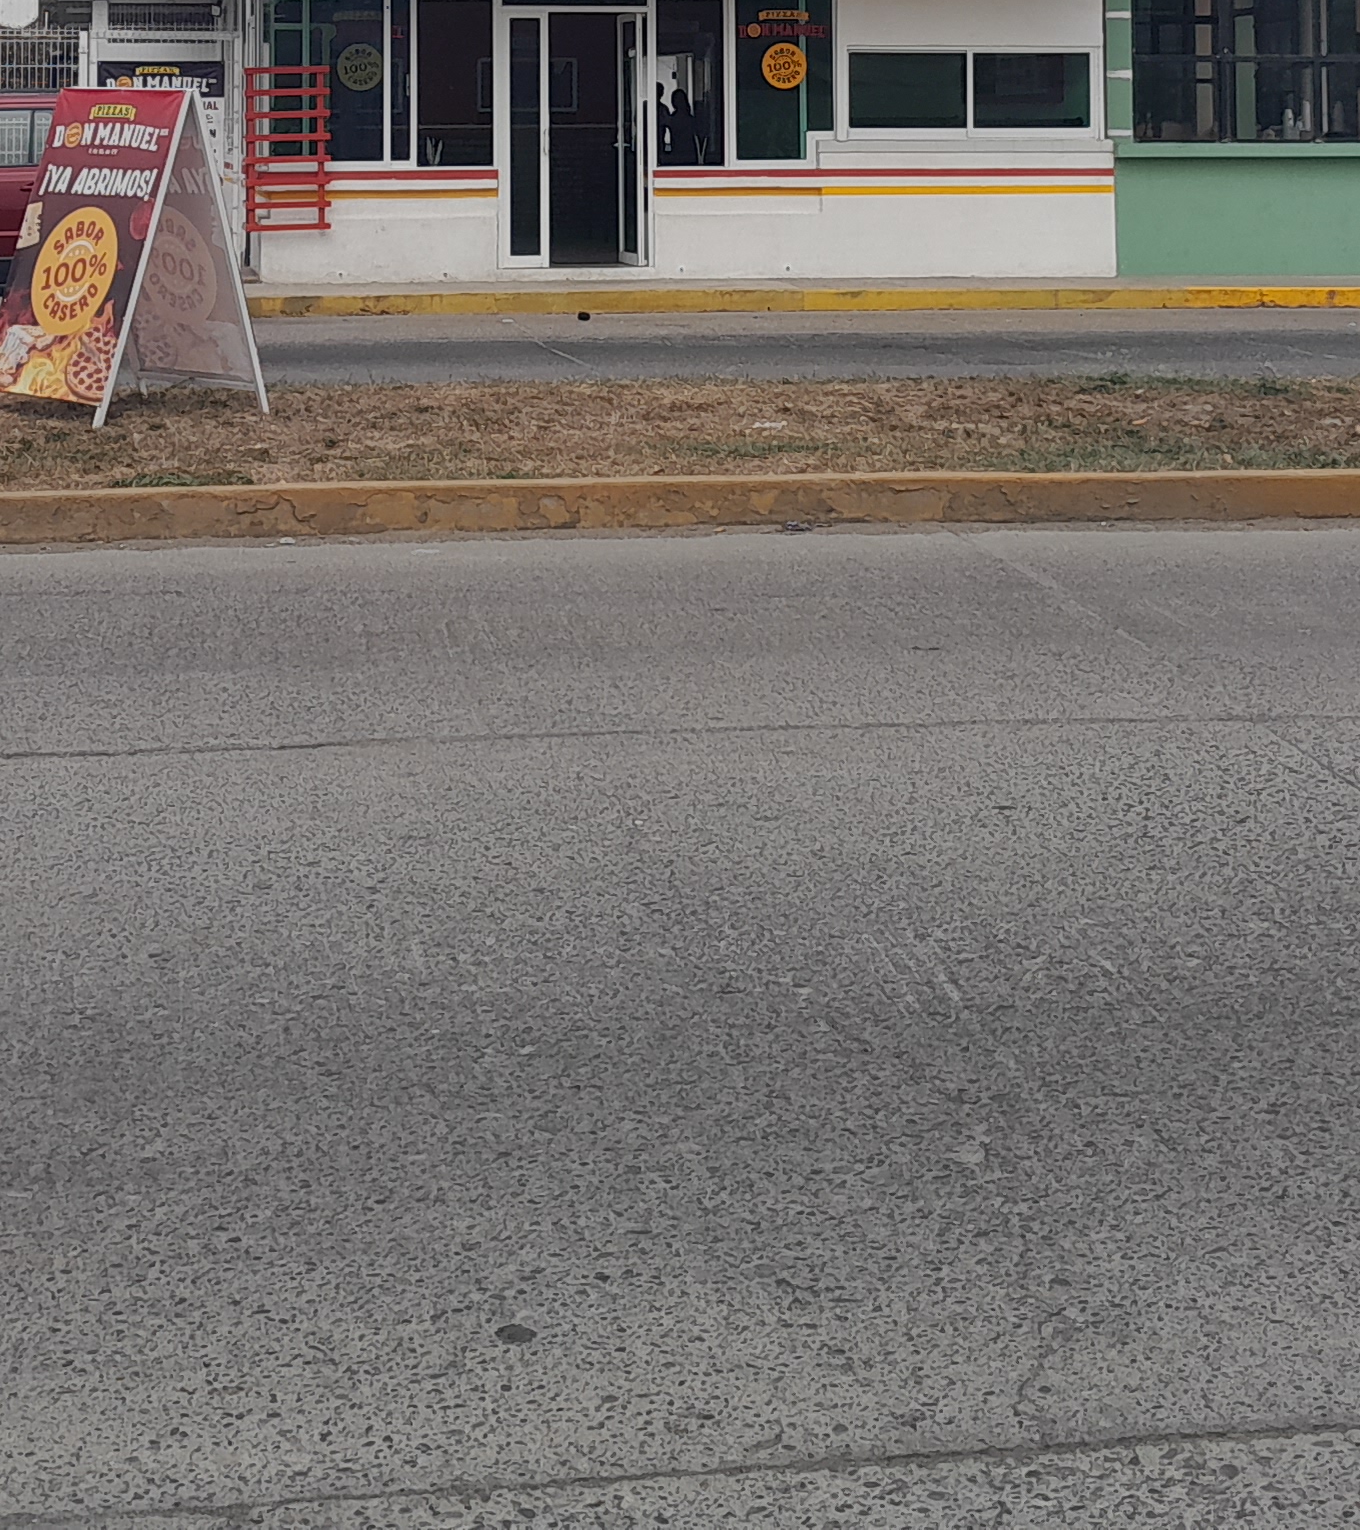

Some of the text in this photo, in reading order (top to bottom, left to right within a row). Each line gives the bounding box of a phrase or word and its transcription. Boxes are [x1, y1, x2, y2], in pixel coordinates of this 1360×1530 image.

[146, 76, 210, 93] MANUEL
[95, 105, 131, 117] PIZZAS
[93, 122, 160, 152] MANUEL
[38, 163, 158, 202] ¡YA ABRIMOS!
[53, 220, 105, 255] SABOR
[40, 251, 108, 291] 100%
[43, 282, 99, 322] CASERO
